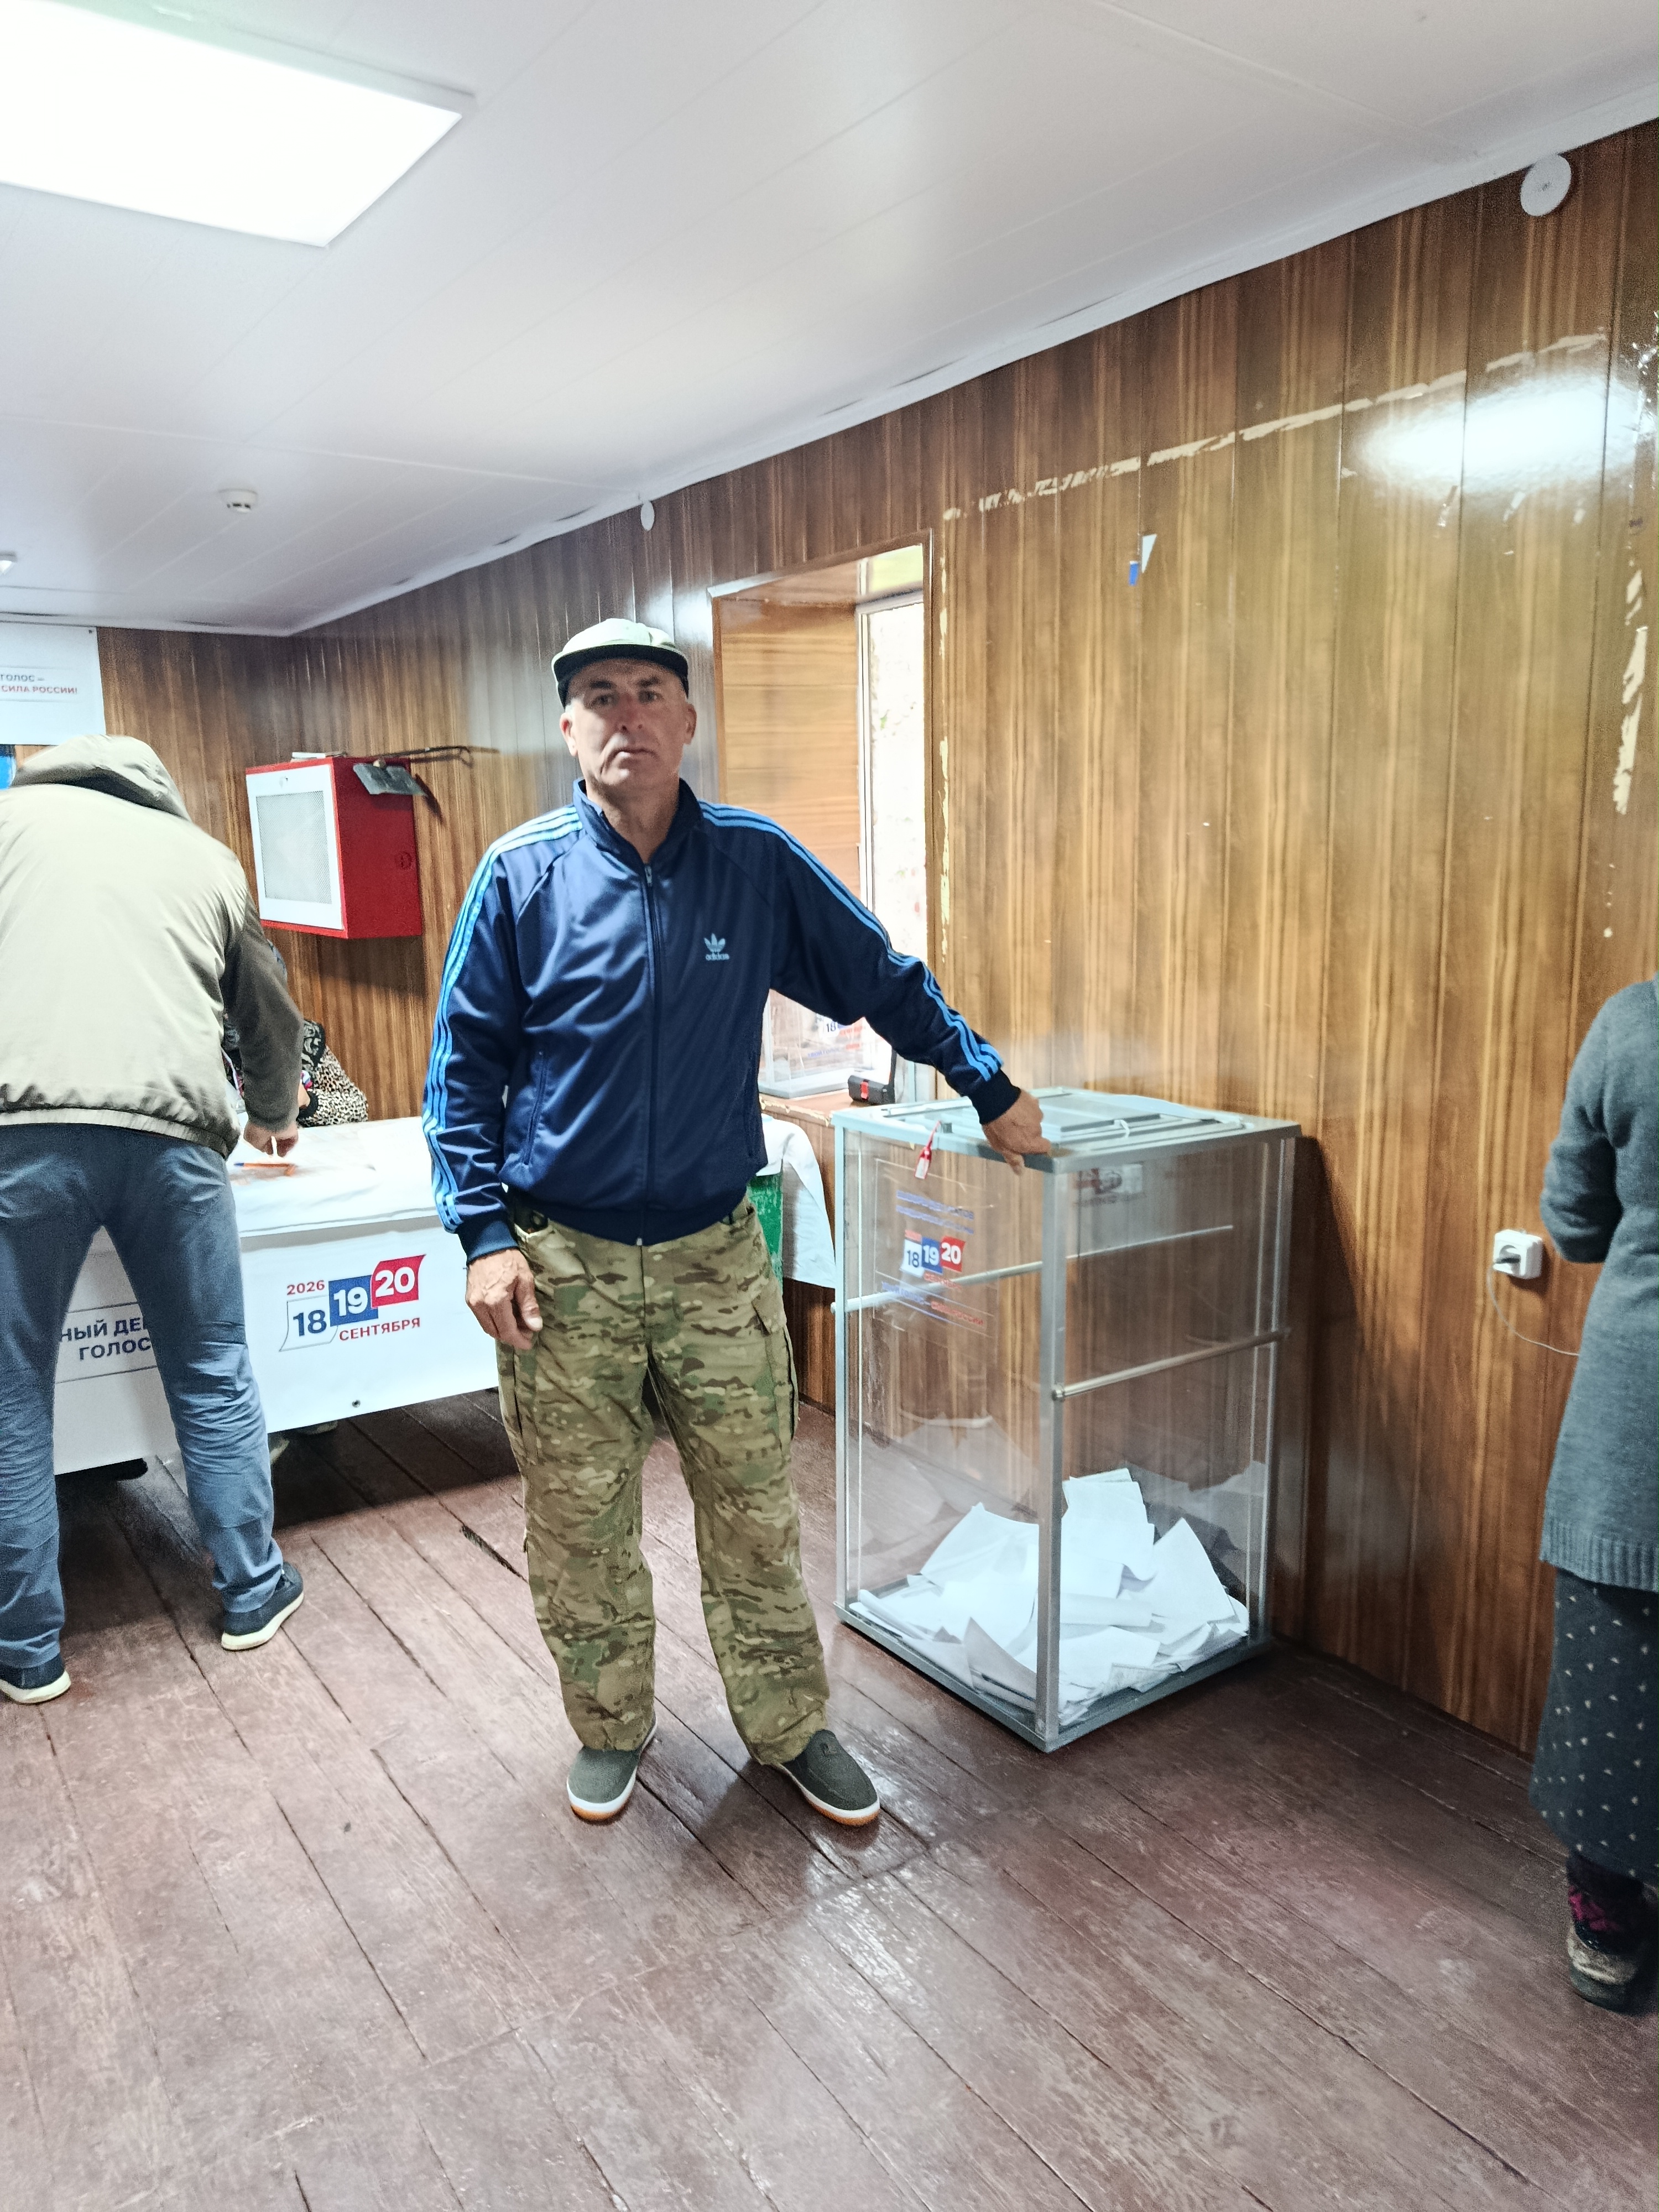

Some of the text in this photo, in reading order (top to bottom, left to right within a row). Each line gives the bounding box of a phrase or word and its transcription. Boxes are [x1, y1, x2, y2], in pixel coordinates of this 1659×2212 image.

[907, 1242, 961, 1267] 18 19 20
[287, 1280, 325, 1295] 2026
[293, 1266, 415, 1337] 18 19 20
[339, 1317, 420, 1341] СЕНТЯБРЯ
[79, 1337, 151, 1360] ГОЛОС
